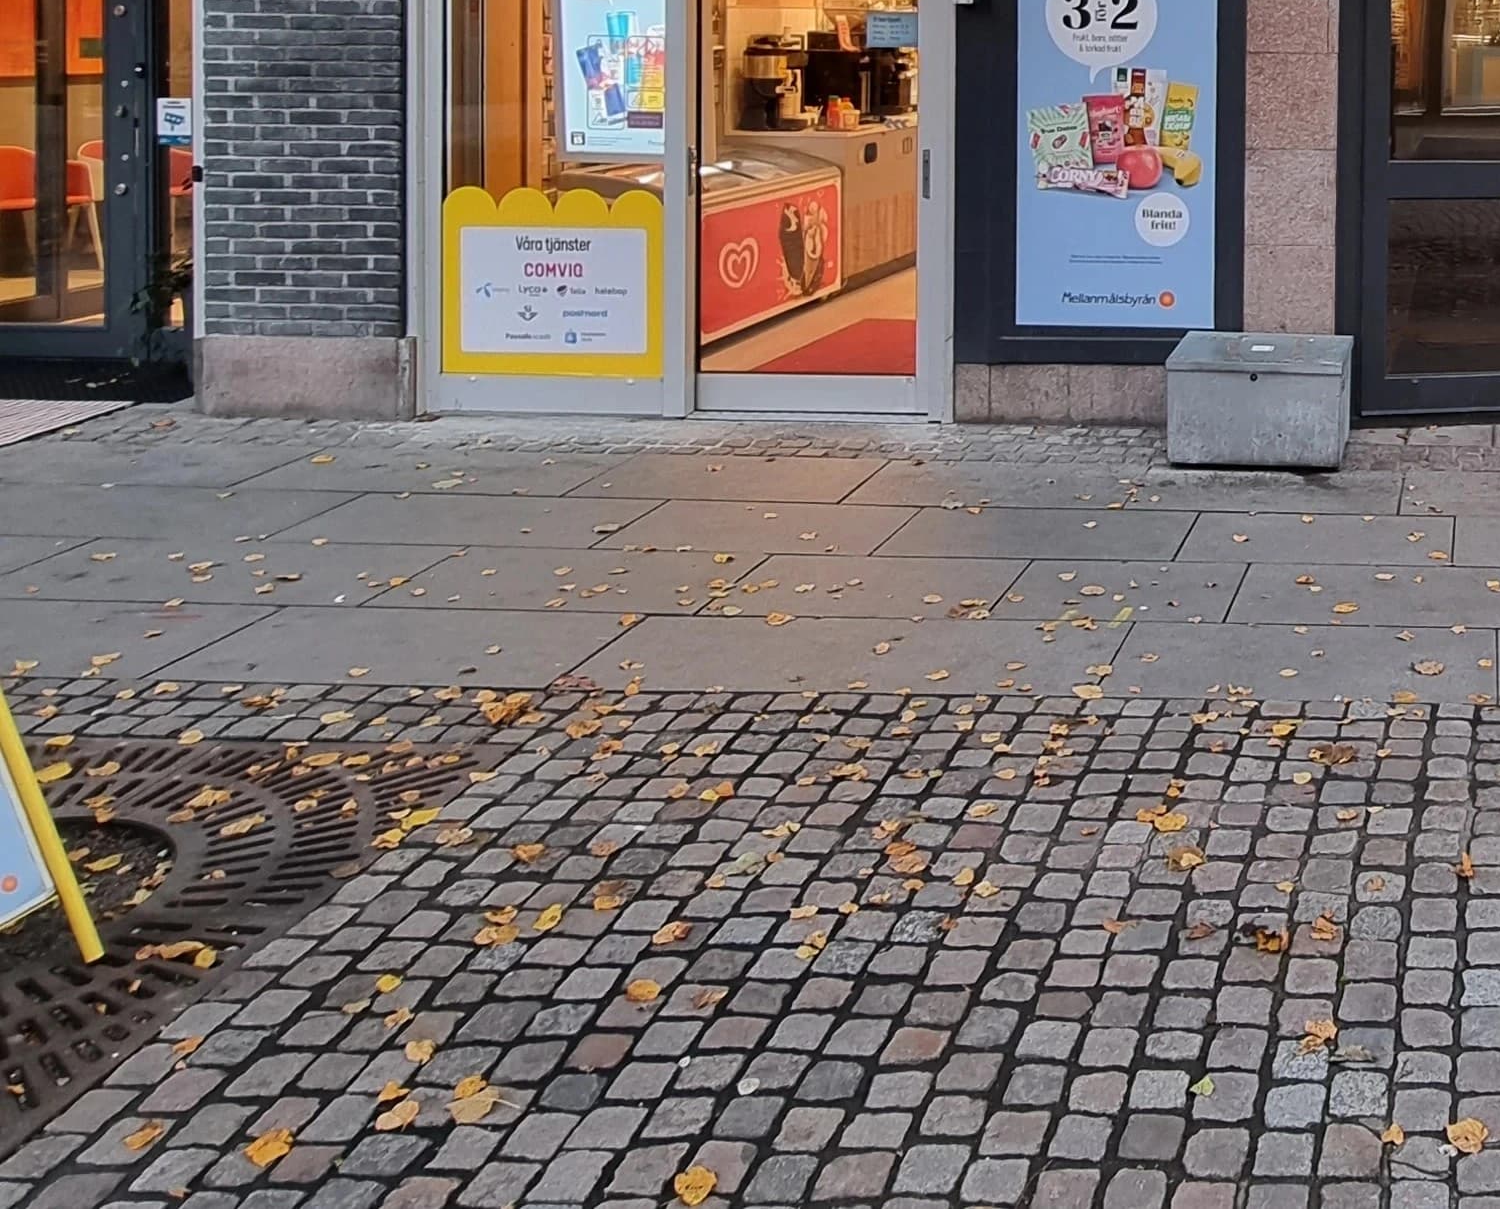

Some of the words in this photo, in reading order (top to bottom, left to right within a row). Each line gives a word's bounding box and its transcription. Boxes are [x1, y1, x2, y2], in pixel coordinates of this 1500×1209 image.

[1049, 166, 1102, 184] CORNY
[1142, 208, 1183, 220] Blanda
[515, 235, 543, 251] Våra
[545, 236, 591, 254] tjänster
[524, 263, 583, 278] COMVIQ
[1062, 292, 1157, 308] Mellanmålsbyrån
[562, 309, 608, 319] postnord
